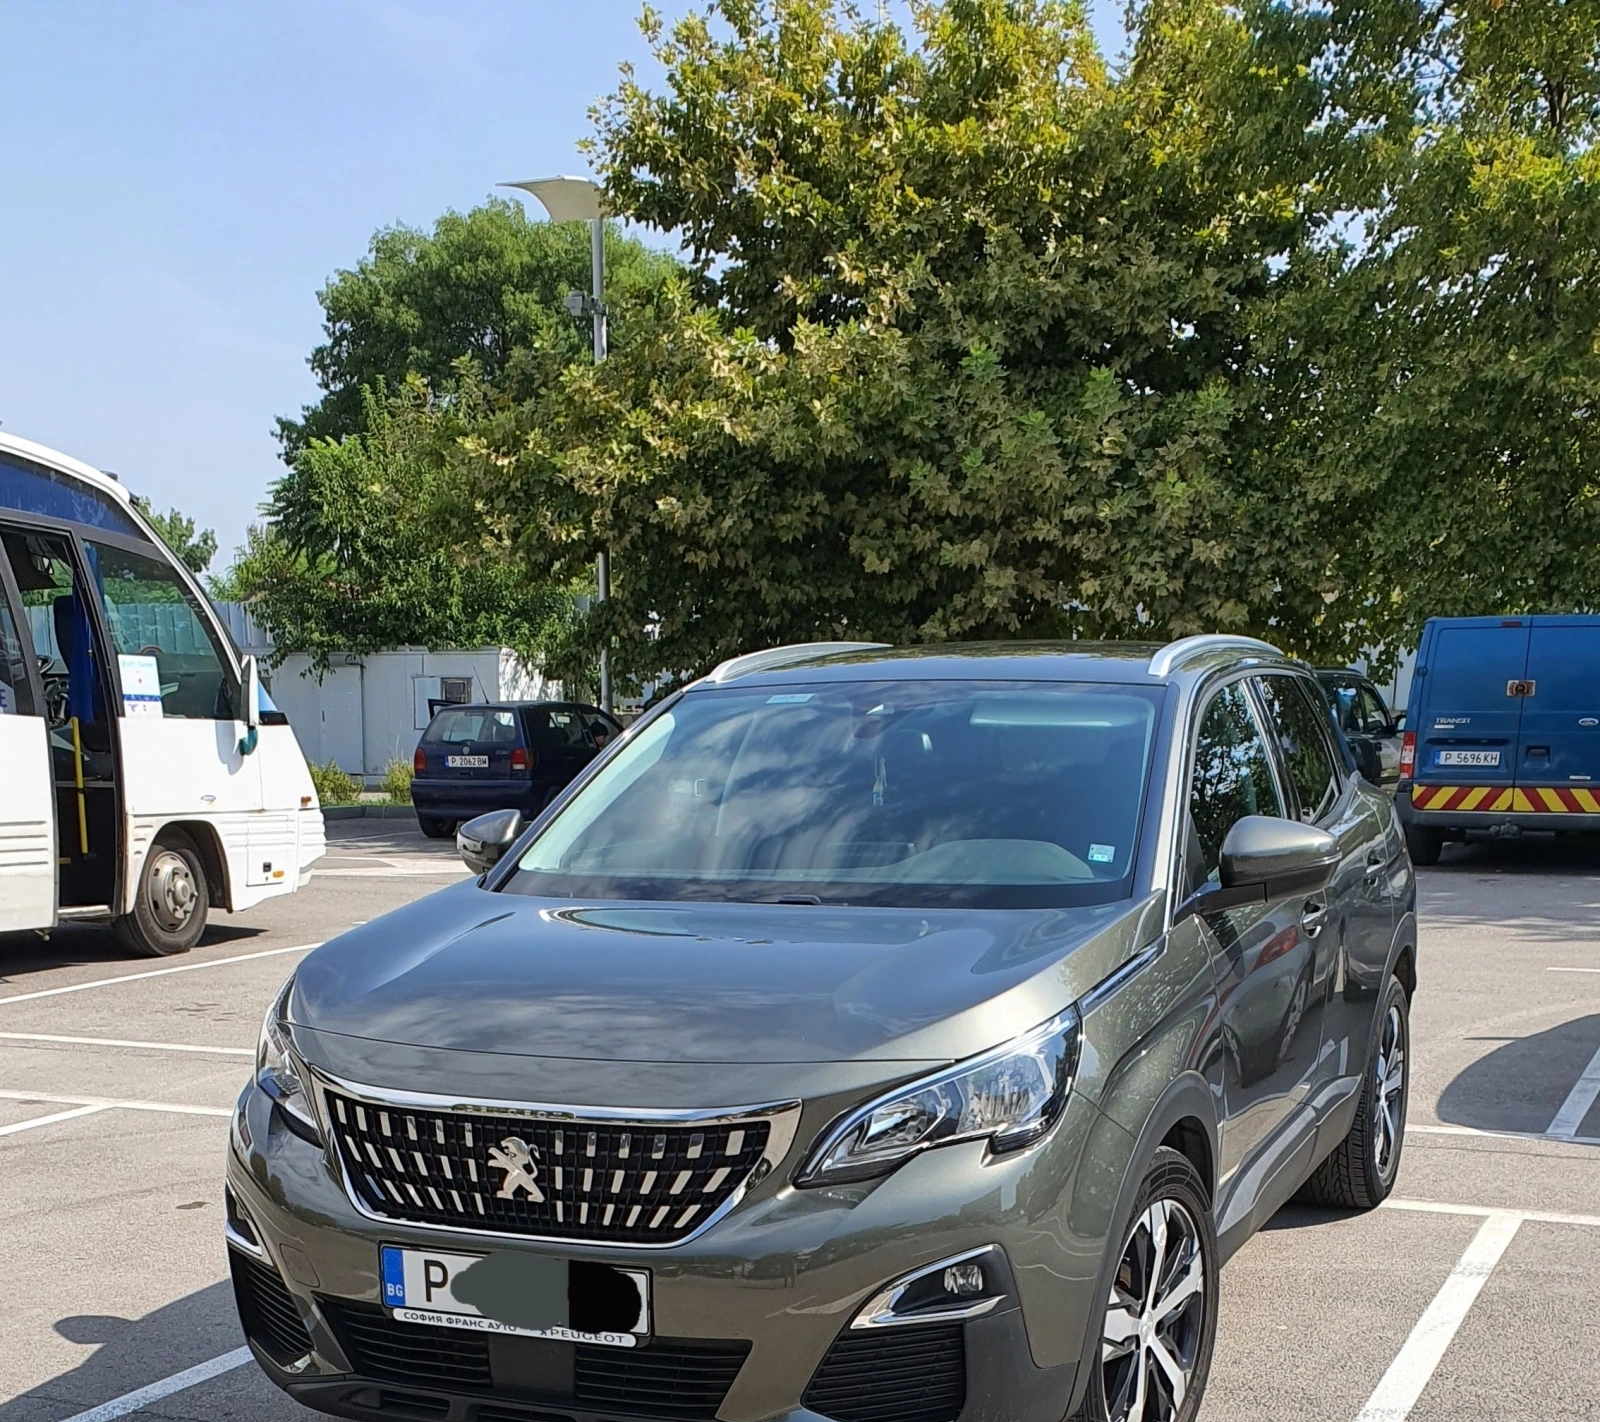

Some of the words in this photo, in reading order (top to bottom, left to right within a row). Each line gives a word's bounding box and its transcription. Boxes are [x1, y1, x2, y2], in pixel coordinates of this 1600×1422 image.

[459, 757, 476, 766] 2062
[1456, 753, 1482, 764] 5696
[423, 1258, 449, 1303] P
[386, 1283, 404, 1298] BG
[403, 1311, 443, 1324] СОФИЯ
[446, 1316, 485, 1329] ФРАНС
[550, 1329, 626, 1343] PEUGEOT
